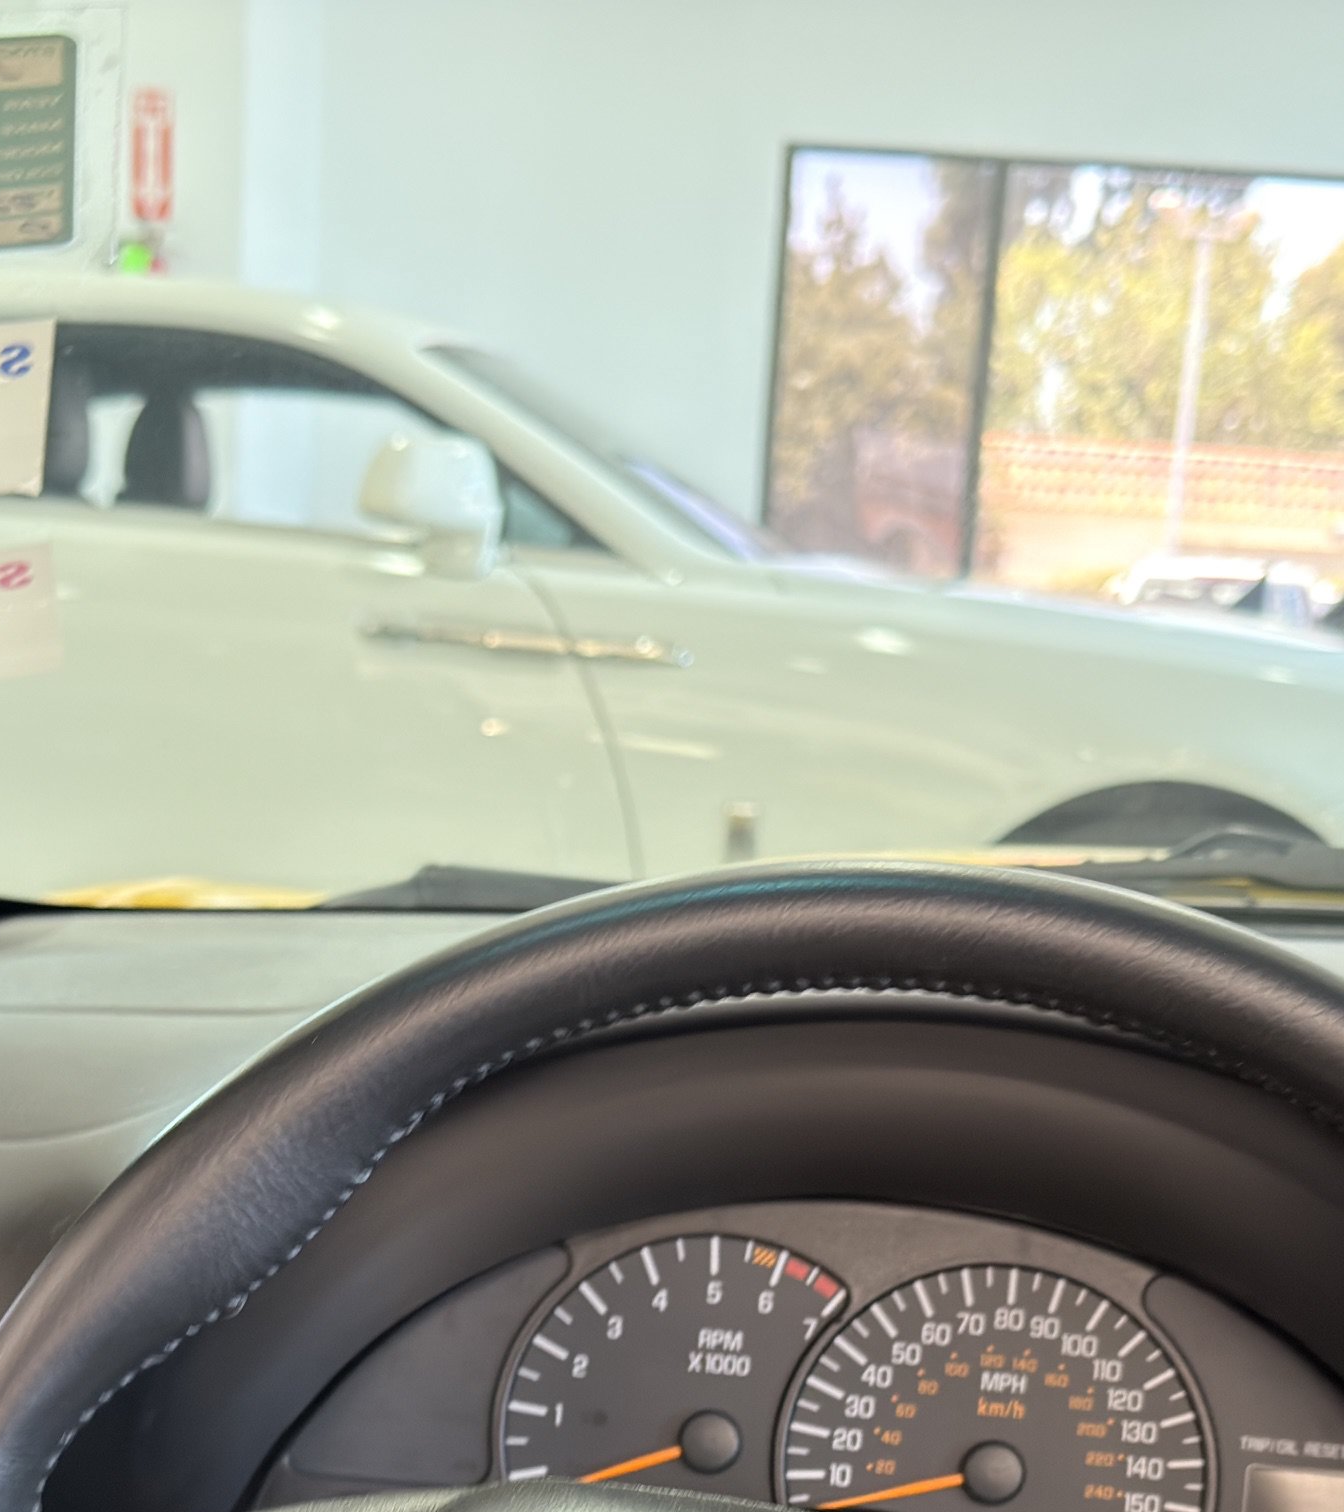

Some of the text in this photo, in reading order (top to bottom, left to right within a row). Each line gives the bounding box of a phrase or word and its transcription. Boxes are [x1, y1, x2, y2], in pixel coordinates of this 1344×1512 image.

[652, 1288, 668, 1312] 4
[707, 1281, 722, 1304] 5
[758, 1291, 774, 1314] 6
[607, 1316, 623, 1340] 3
[803, 1319, 818, 1340] 7
[957, 1313, 985, 1336] 70
[995, 1310, 1025, 1331] 80
[1030, 1316, 1059, 1338] 90
[698, 1328, 744, 1351] RPM
[921, 1323, 952, 1346] 60
[1061, 1334, 1098, 1357] 100
[687, 1352, 751, 1377] X1000
[891, 1343, 922, 1365] 50
[572, 1354, 589, 1378] 2
[861, 1366, 893, 1388] 40
[1093, 1359, 1122, 1381] 110
[980, 1373, 1027, 1394] MPH
[845, 1396, 875, 1418] 30
[976, 1398, 1026, 1420] km/h
[1107, 1389, 1142, 1411] 120
[555, 1403, 564, 1427] 1
[833, 1429, 863, 1451] 20
[1121, 1421, 1156, 1444] 130
[830, 1463, 852, 1487] 10
[1127, 1457, 1162, 1480] 140
